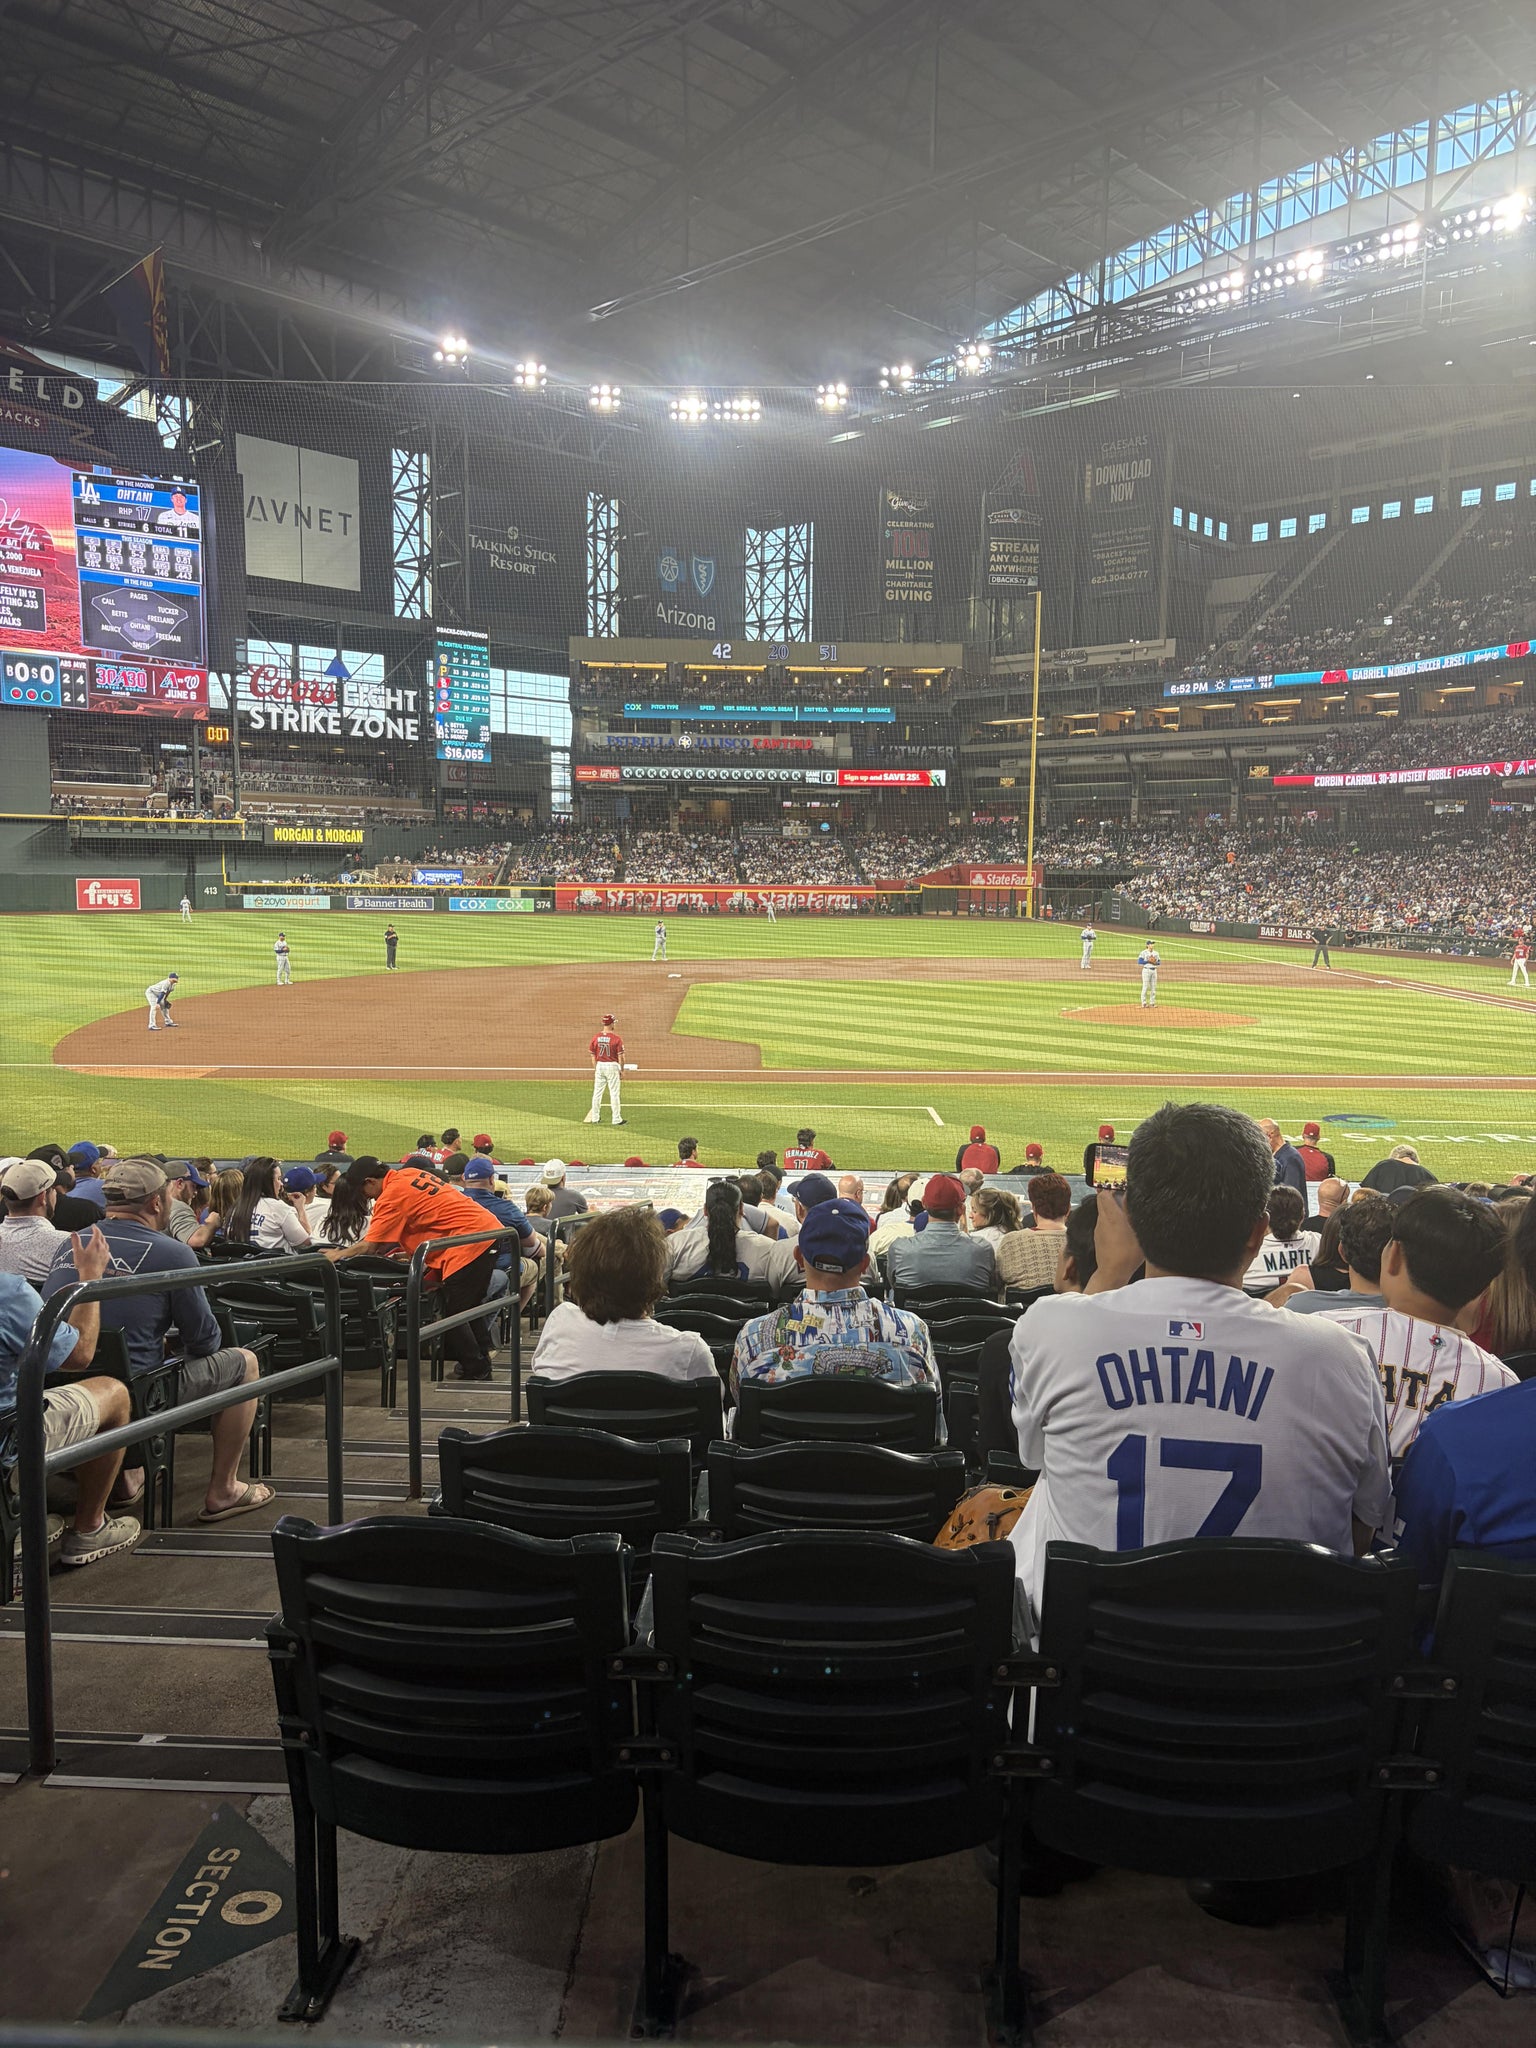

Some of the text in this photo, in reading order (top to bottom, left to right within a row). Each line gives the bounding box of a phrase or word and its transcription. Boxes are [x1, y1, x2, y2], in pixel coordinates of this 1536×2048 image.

[1096, 458, 1151, 486] DOWNLOAD
[78, 475, 100, 505] LA
[135, 481, 154, 489] MOUND
[117, 489, 153, 503] OHTANI
[1110, 481, 1134, 503] NOW
[118, 506, 151, 521] RHP 17
[246, 495, 353, 536] AVNET
[104, 518, 110, 527] 5
[142, 523, 149, 532] 6
[154, 526, 173, 534] TOTAL
[177, 527, 188, 537] 11
[886, 520, 935, 529] CELEBRATING
[26, 541, 40, 550] R/R
[468, 534, 557, 564] TALKING STICK
[990, 541, 1040, 554] STREAM
[6, 552, 23, 561] 2000
[989, 554, 1040, 564] ANY GAME
[1103, 556, 1137, 567] LOCATION
[489, 553, 537, 575] RESORT
[885, 559, 934, 571] MILLION
[989, 564, 1039, 574] ANYWHERE
[7, 564, 42, 577] VENEZUELA
[140, 579, 153, 587] FIELD
[991, 576, 1027, 584] DBACKS.TV
[1091, 570, 1149, 585] 623.304.0777
[885, 580, 934, 589] CHARITABLE
[19, 589, 36, 599] IN 12
[129, 592, 148, 601] PAGES
[885, 590, 933, 602] GIVING
[23, 599, 38, 609] .333
[101, 597, 115, 606] CALL
[111, 610, 128, 618] BETTS
[158, 606, 179, 616] TUCKER
[656, 602, 716, 631] Arizona
[148, 615, 175, 625] FREELAND
[101, 624, 121, 633] MUNCY
[130, 622, 151, 631] OHTANI
[436, 626, 488, 639] DBACKS.COM/PROMOS
[155, 632, 181, 642] FREEMAN
[132, 641, 150, 650] SMITH
[712, 642, 838, 661] 42 20 51
[60, 660, 72, 668] ABS
[1352, 668, 1386, 680] GABRIEL
[1387, 664, 1416, 678] MORENO
[1417, 659, 1441, 673] SOCCER
[1442, 654, 1466, 669] JERSEY
[6, 662, 55, 685] B 0 S 0
[62, 673, 85, 685] 2 4
[248, 663, 418, 712] Coors LIGHT
[1170, 682, 1208, 694] 6:52 PM
[63, 692, 85, 703] 2 4
[165, 689, 197, 700] JUNE 6
[624, 703, 642, 711] COX
[250, 705, 419, 741] STRIKE ZONE
[207, 726, 229, 741] 0:07
[607, 735, 814, 751] ESTRELLA JALISCO CANTINA
[444, 745, 484, 761] $16,065
[825, 773, 832, 781] 0
[844, 774, 859, 782] Sign
[883, 773, 905, 781] SAVE
[1314, 767, 1482, 788] CORBIN CARROLL 30-30 MYSTERY BOBBLE CHASE
[274, 827, 364, 843] MORGAN & MORGAN
[987, 873, 1034, 886] State Farm
[83, 881, 134, 907] fry's
[203, 886, 218, 896] 413
[364, 898, 428, 909] Banner Health
[459, 900, 524, 910] COX COX
[536, 900, 551, 909] 374
[1260, 926, 1311, 939] BAR-S BAR-S
[598, 1043, 610, 1057] 71
[1341, 1132, 1485, 1143] STICK
[794, 1159, 808, 1170] 11
[1263, 1249, 1312, 1272] MARTE
[1095, 1346, 1275, 1422] OHTANI
[1107, 1433, 1263, 1552] 17
[137, 1847, 240, 1970] SECTION
